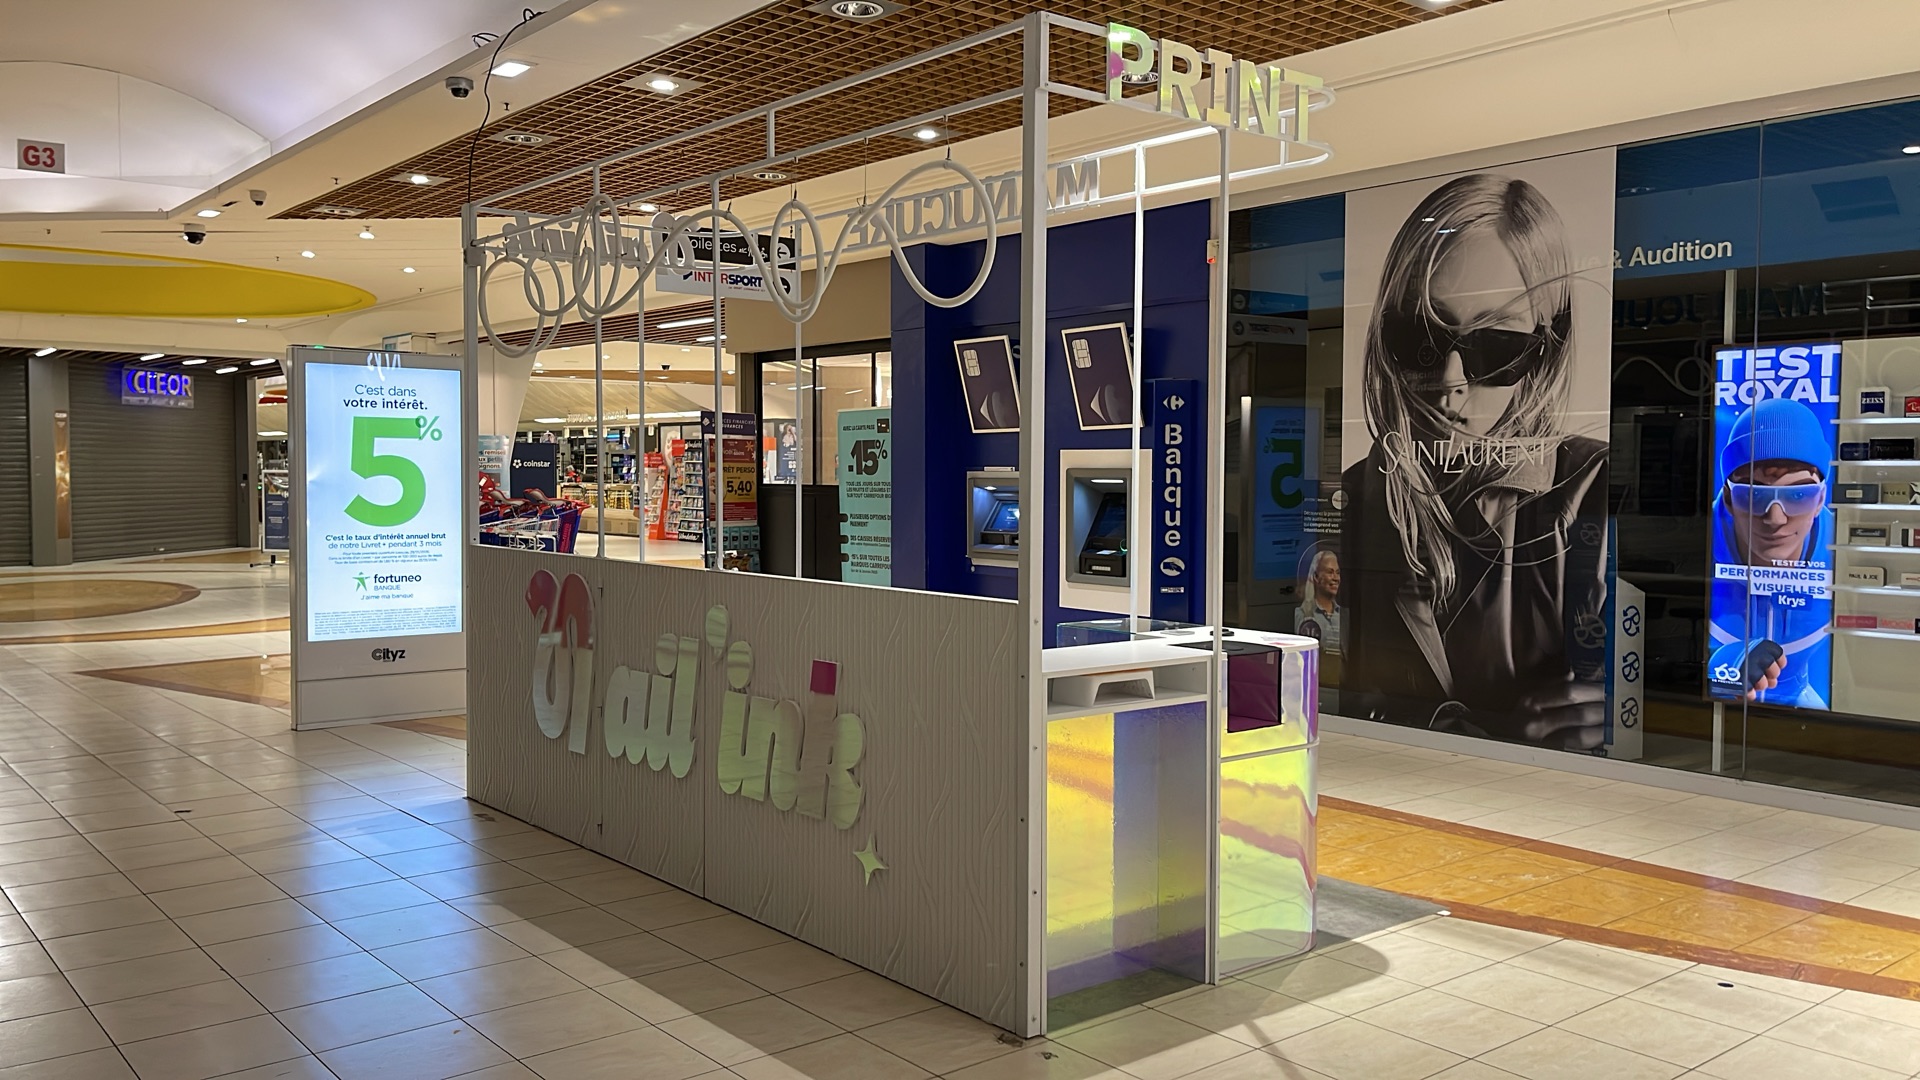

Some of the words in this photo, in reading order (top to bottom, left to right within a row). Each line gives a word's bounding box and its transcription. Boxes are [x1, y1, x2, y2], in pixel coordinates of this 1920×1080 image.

[1107, 22, 1323, 143] PRINT
[23, 145, 56, 168] G3
[1628, 240, 1733, 267] Audition
[1716, 345, 1841, 381] TEST
[132, 370, 192, 397] CLEOR
[355, 384, 385, 396] C'est
[388, 386, 417, 397] dans
[1714, 377, 1840, 406] ROYAL
[343, 399, 378, 408] votre
[382, 398, 428, 410] intérêt.
[343, 415, 443, 528] 5%
[1164, 424, 1183, 547] Banque
[1720, 567, 1826, 581] PERFORMANCES
[1772, 559, 1806, 568] TESTEZ
[374, 574, 422, 583] fortuneo
[1754, 583, 1825, 594] VISUELLES
[1778, 595, 1806, 607] Krys
[372, 648, 406, 661] Cityz
[525, 568, 866, 830] Nail'ink
